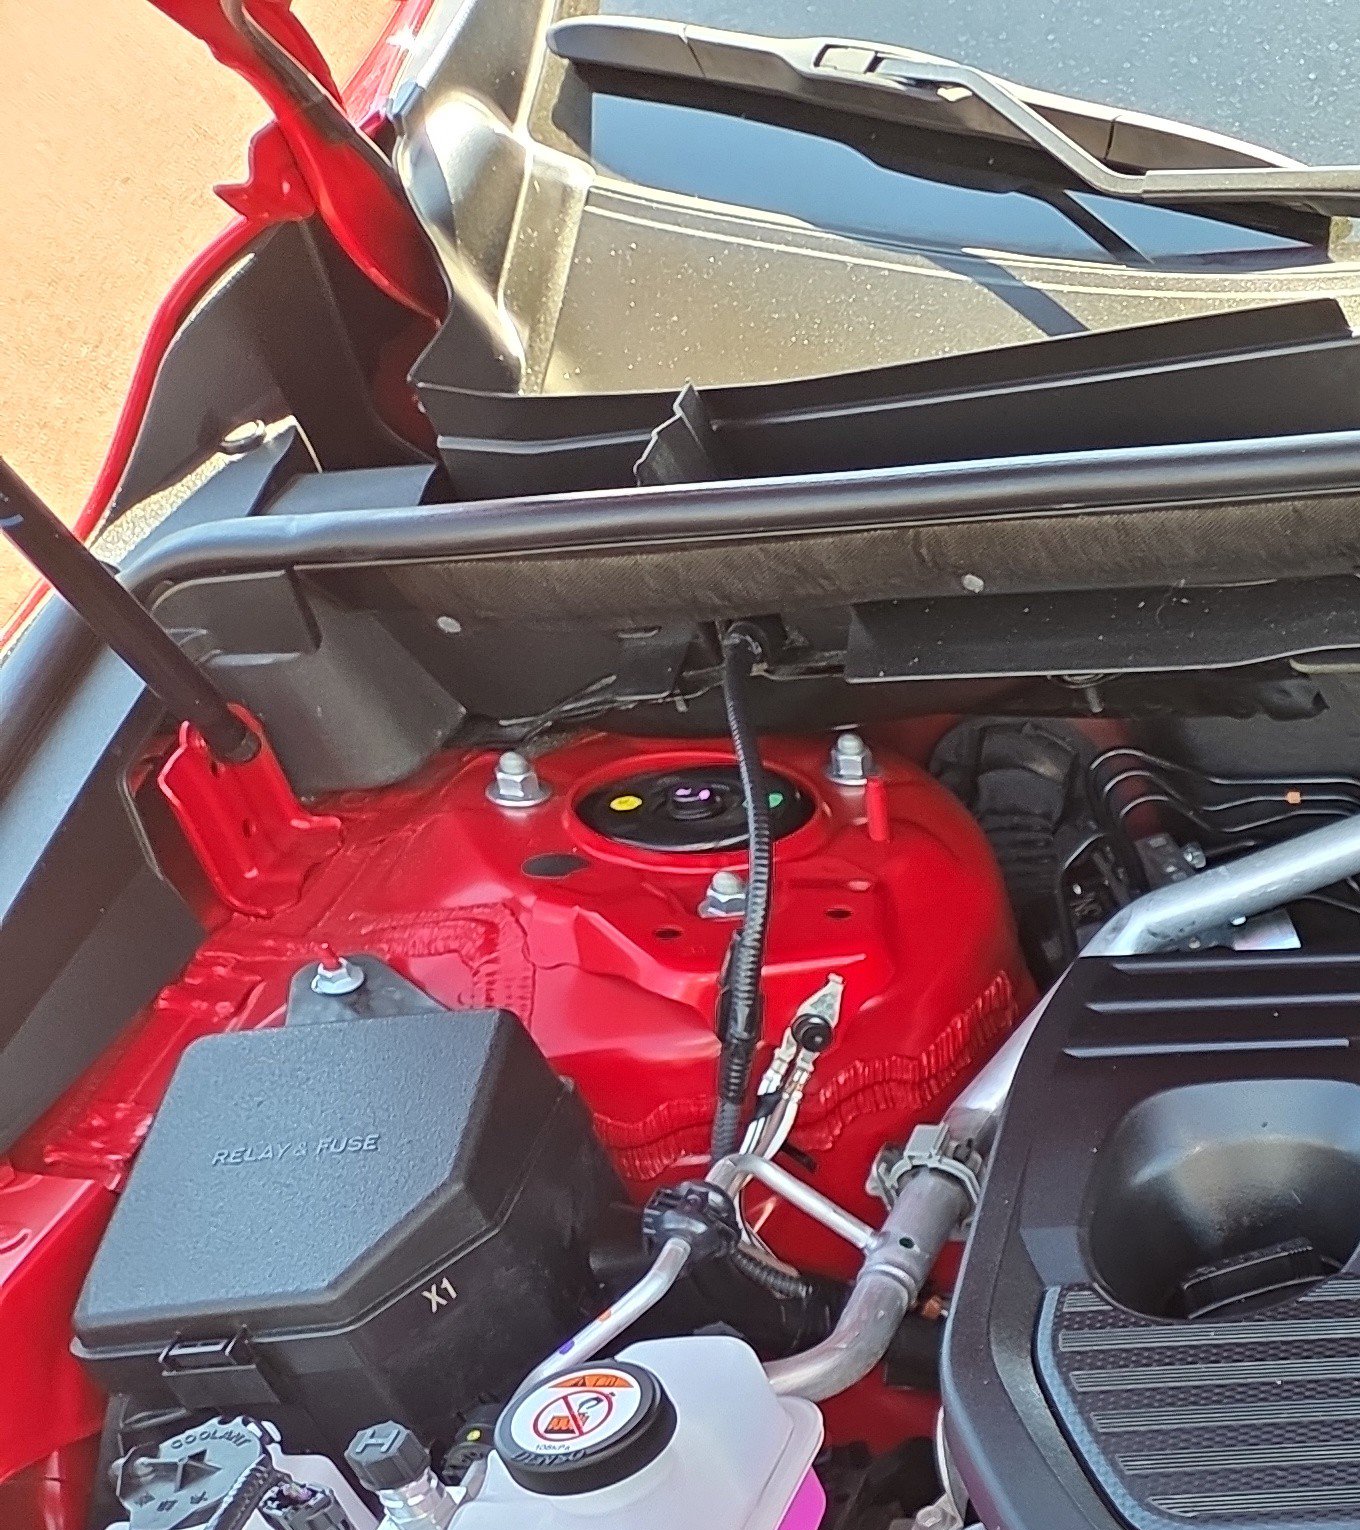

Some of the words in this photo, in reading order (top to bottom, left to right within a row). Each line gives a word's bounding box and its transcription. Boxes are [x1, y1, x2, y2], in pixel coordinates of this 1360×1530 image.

[211, 1141, 292, 1167] RELAY
[315, 1133, 381, 1157] FUSE
[421, 1277, 458, 1314] X1
[170, 1429, 252, 1450] COOLANT
[355, 1427, 401, 1454] H
[511, 1449, 588, 1467] DENSO
